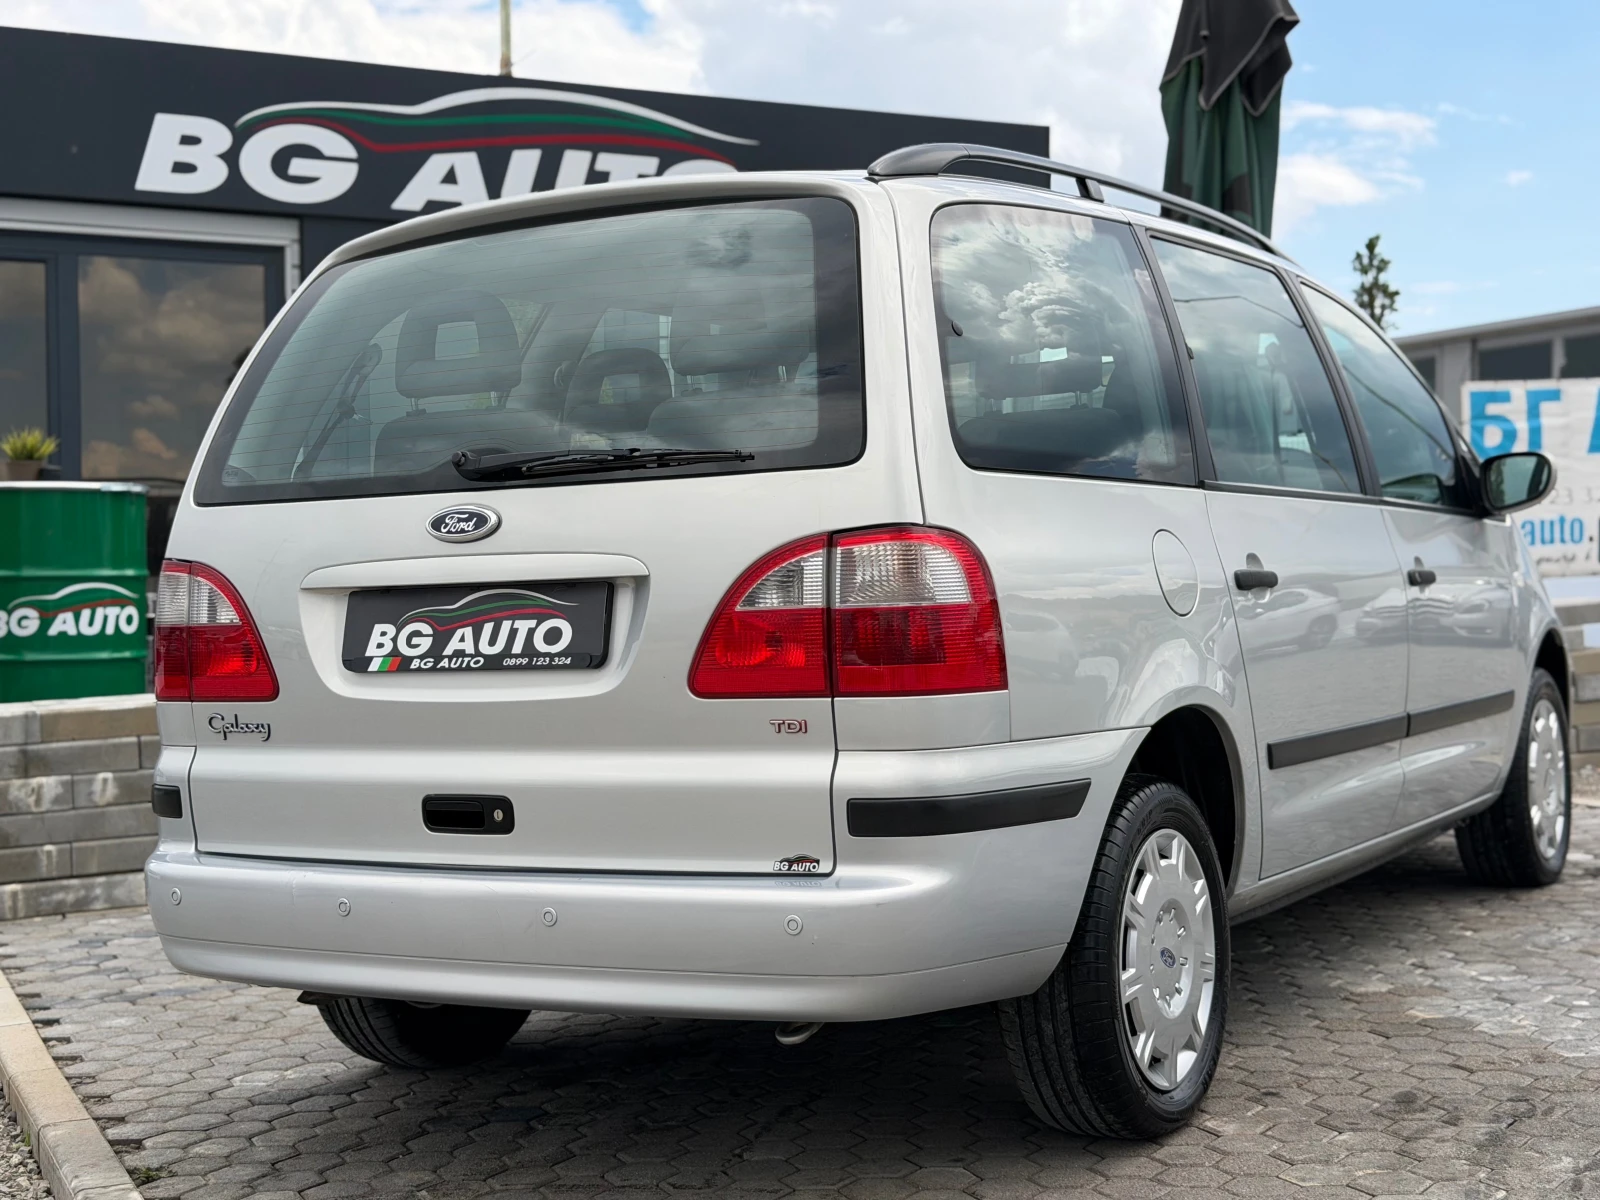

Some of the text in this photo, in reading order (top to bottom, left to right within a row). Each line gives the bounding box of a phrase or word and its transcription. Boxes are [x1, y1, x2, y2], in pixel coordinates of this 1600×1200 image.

[134, 112, 738, 212] BG AUT
[1470, 388, 1561, 461] БГ
[440, 513, 477, 533] Ford
[47, 605, 139, 636] AUTO
[365, 618, 573, 656] BG AUTO
[409, 656, 485, 669] BG AUTO
[502, 656, 572, 666] 0899 123 324
[207, 712, 271, 742] Galaxy
[769, 719, 808, 734] TDI
[774, 861, 819, 872] BG AUTO
